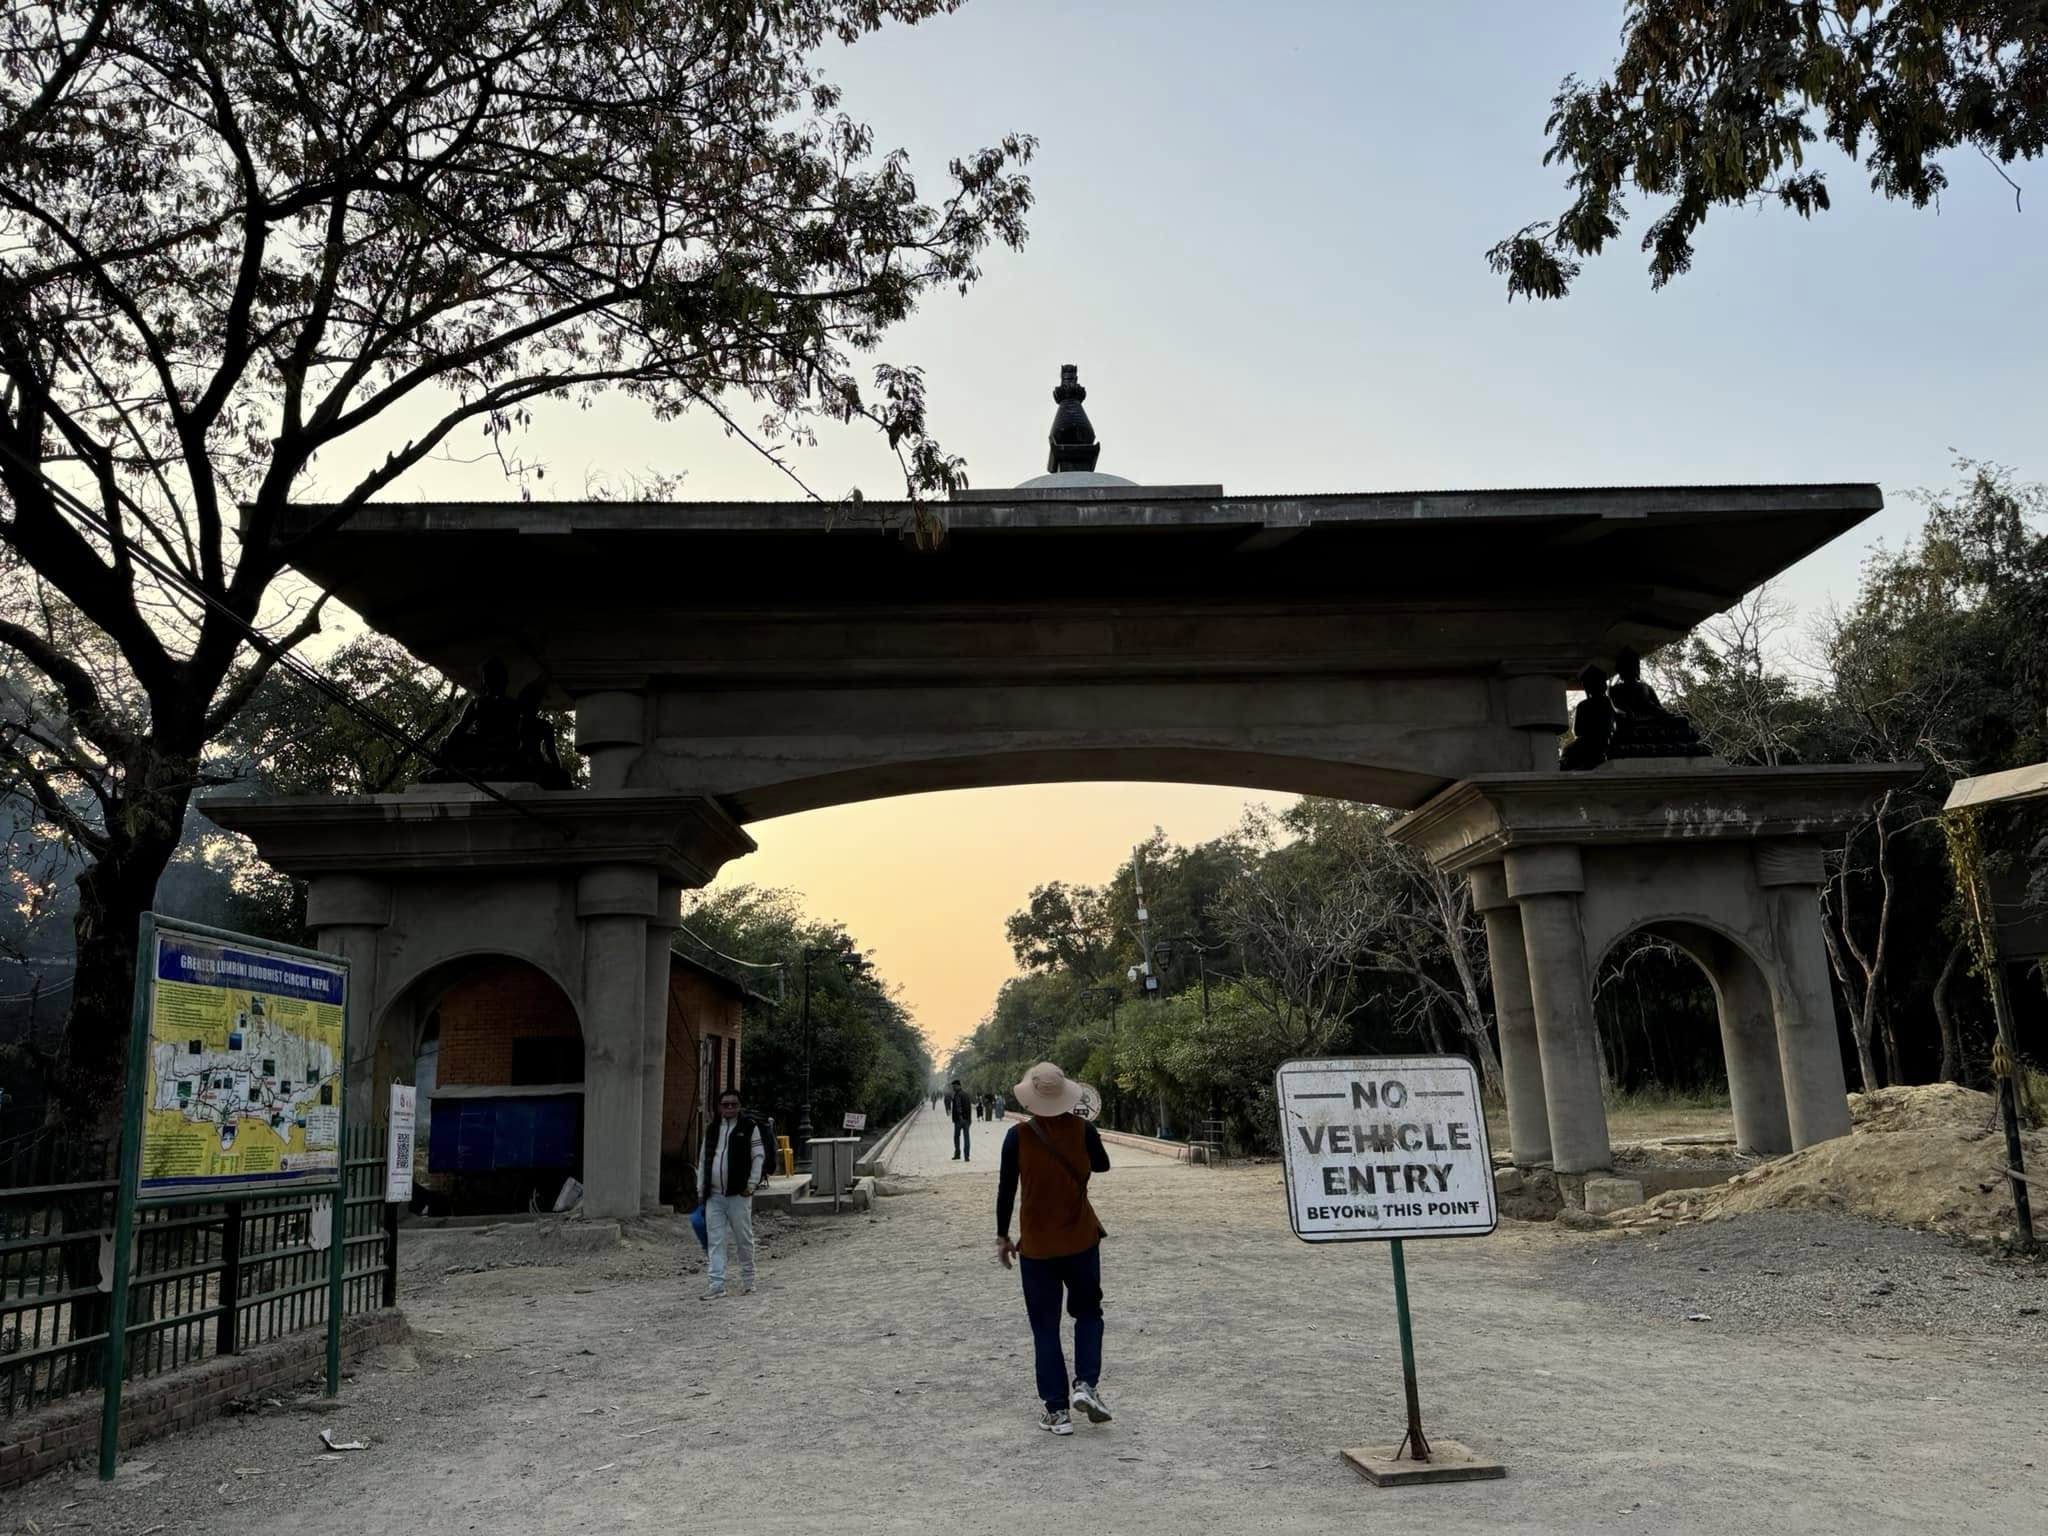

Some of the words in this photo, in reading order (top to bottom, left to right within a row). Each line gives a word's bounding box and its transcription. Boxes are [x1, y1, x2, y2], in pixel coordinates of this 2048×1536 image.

[217, 961, 247, 977] LUMBINI
[248, 965, 283, 982] BUDDHIST
[311, 977, 330, 992] NEPAL
[1351, 1081, 1408, 1109] NO
[1298, 1122, 1472, 1155] VEHICLE
[1322, 1163, 1453, 1196] ENTRY
[1307, 1204, 1379, 1220] BEYOND
[1383, 1203, 1423, 1217] THIS
[1428, 1201, 1480, 1215] POINT
